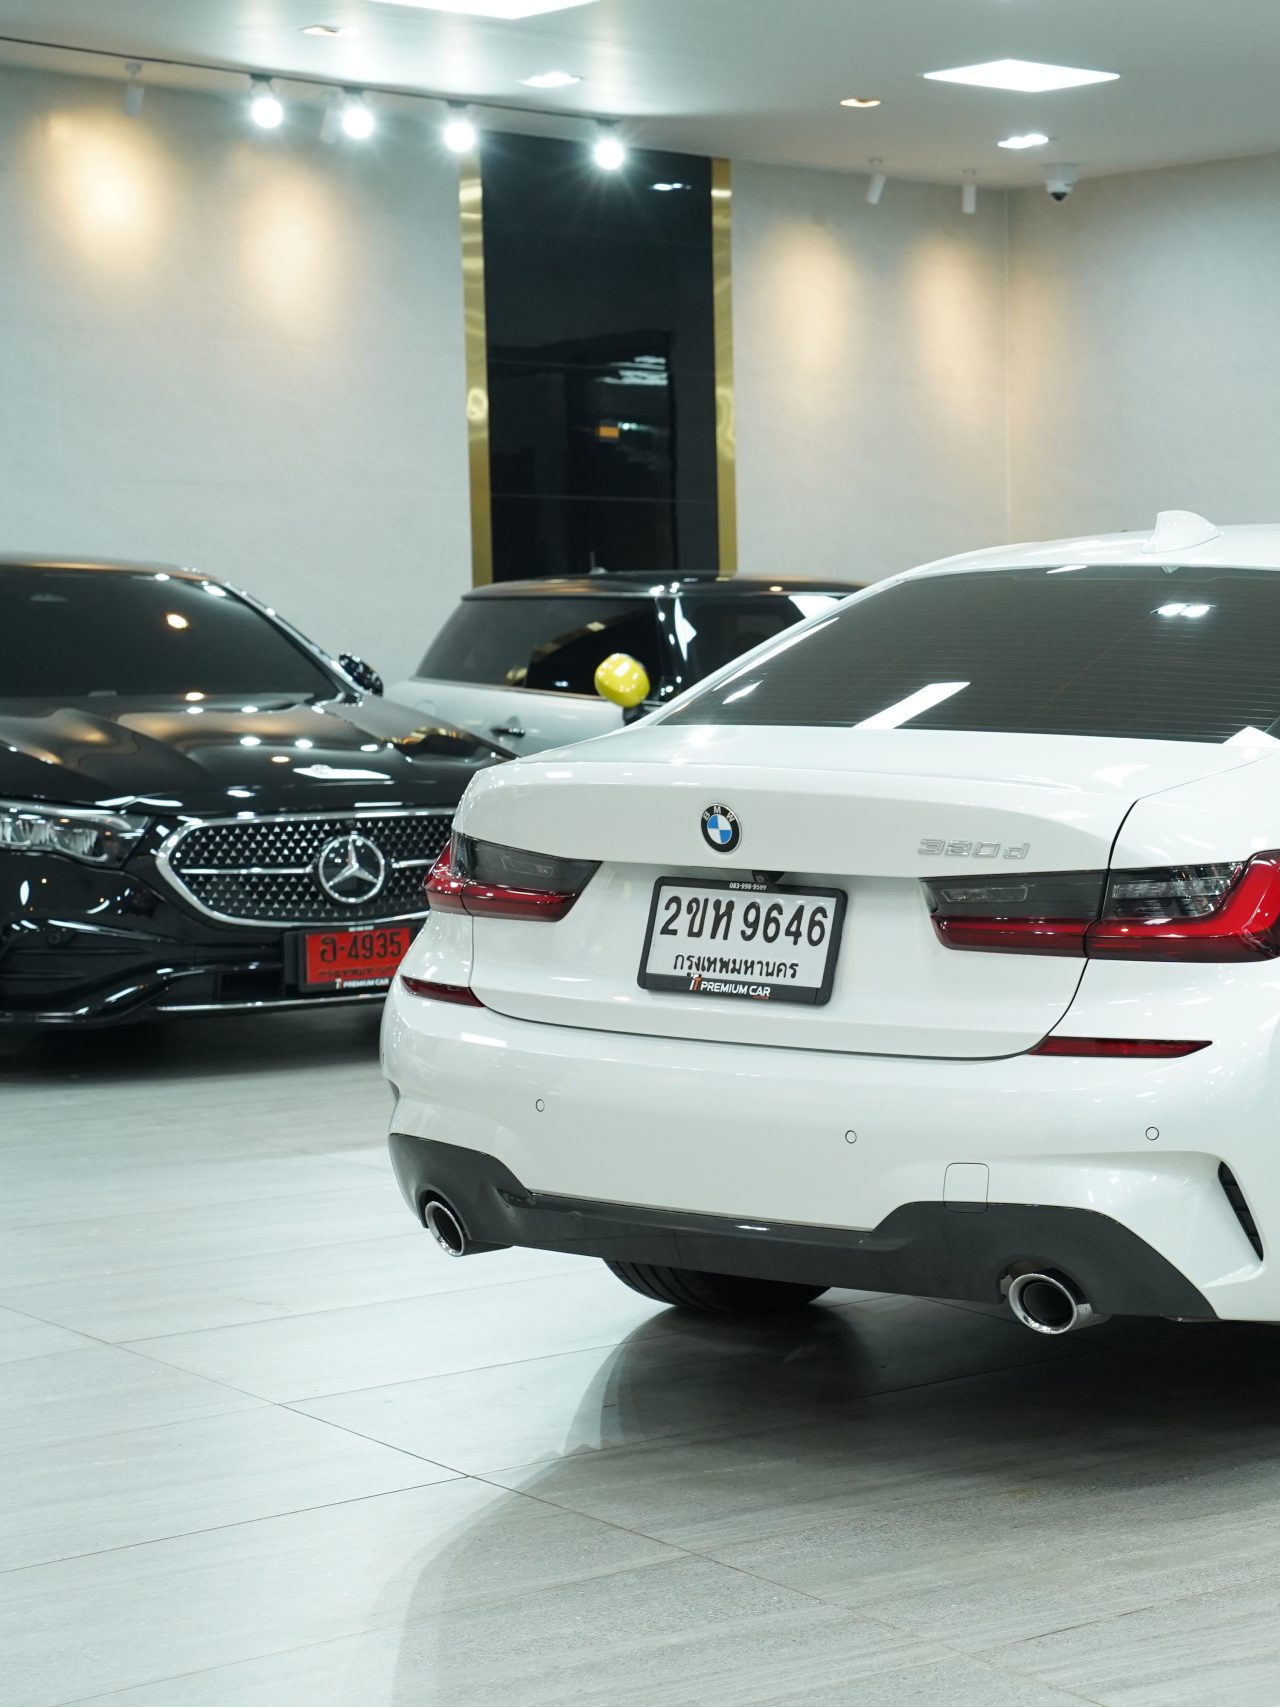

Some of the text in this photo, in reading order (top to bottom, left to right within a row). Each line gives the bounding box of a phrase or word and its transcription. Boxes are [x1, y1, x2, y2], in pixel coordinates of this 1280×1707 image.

[702, 805, 735, 823] BMW
[740, 901, 828, 947] 9646
[701, 981, 748, 995] PREMIUM
[749, 985, 771, 997] CAR
